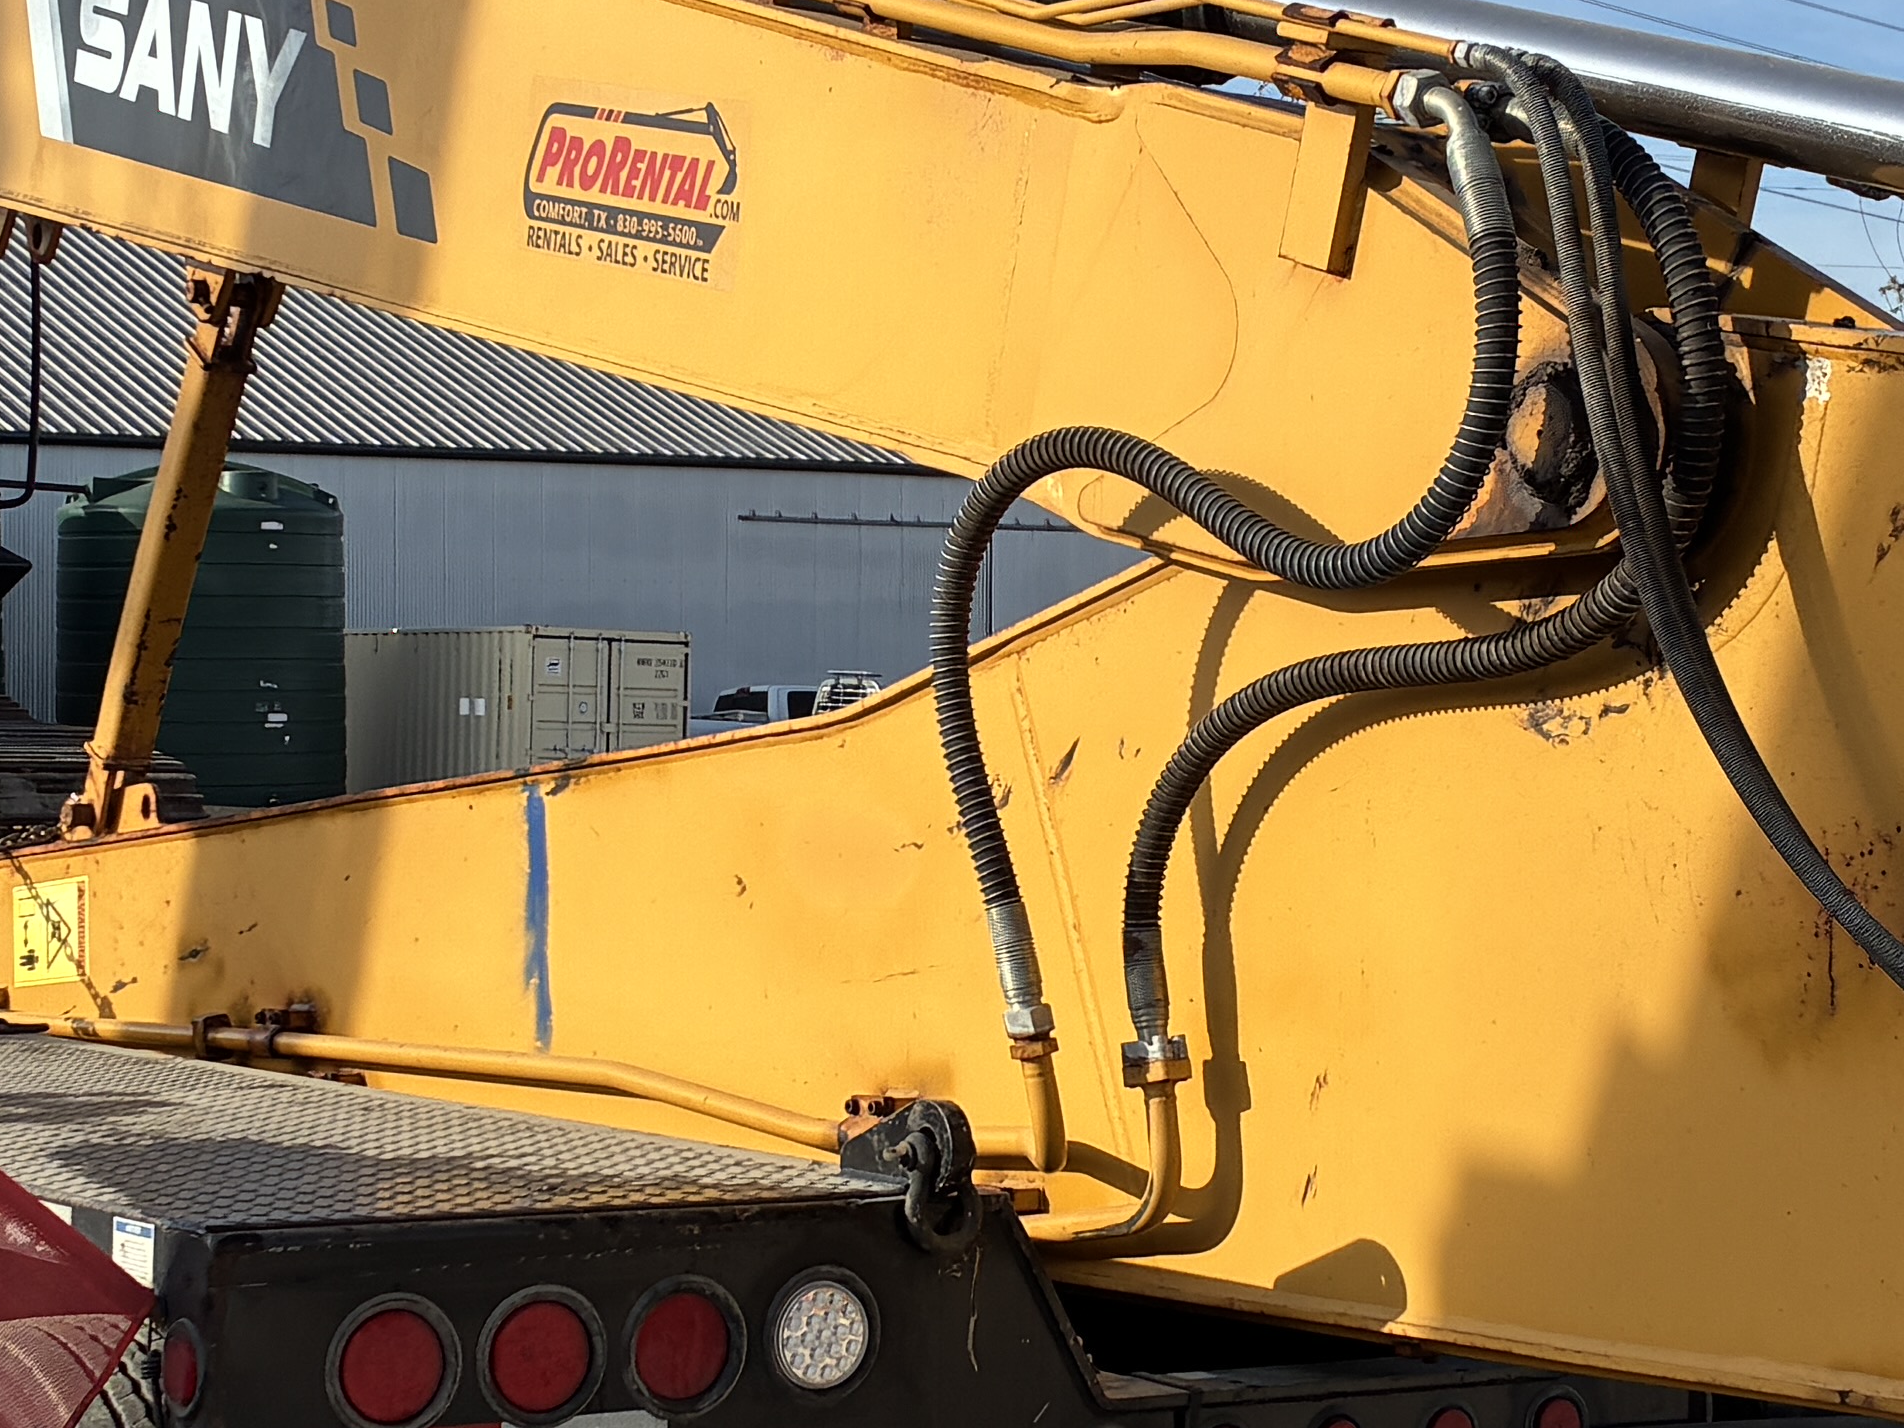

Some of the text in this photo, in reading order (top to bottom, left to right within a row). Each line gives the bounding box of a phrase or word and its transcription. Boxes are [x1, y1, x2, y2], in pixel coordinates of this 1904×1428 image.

[533, 199, 697, 246] COMFORT, TX 830-995-5600
[710, 199, 741, 223] .COM
[527, 225, 710, 282] RENTALS SALES SERVICE
